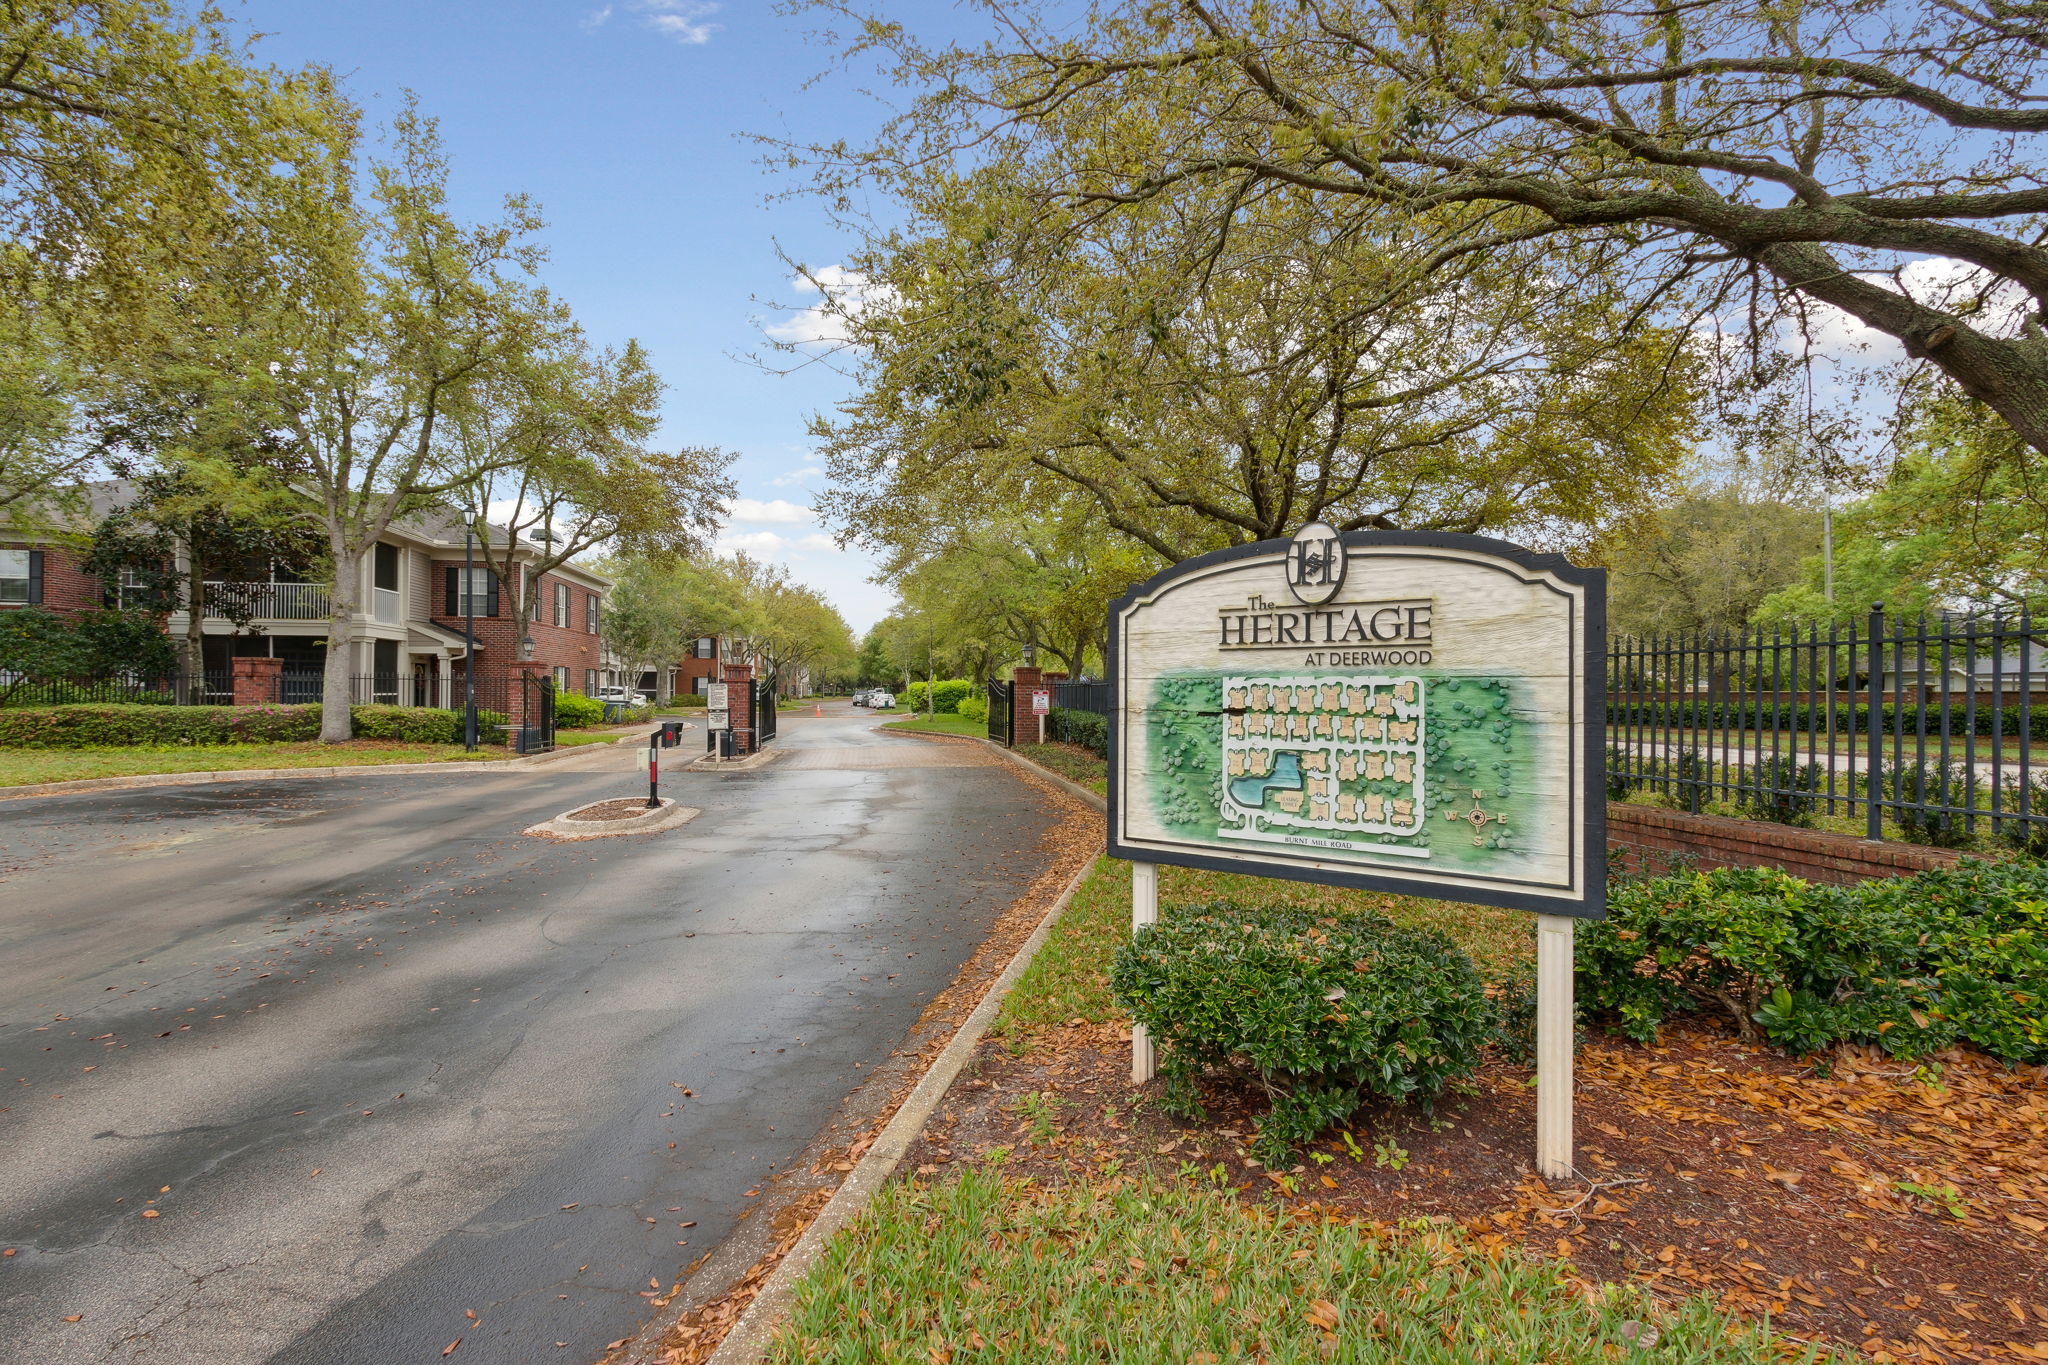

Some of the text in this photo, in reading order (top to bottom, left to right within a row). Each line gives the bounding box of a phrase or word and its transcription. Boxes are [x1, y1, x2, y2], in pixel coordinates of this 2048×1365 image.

[1248, 595, 1275, 611] The
[1219, 605, 1432, 645] HERITAGE
[1305, 651, 1432, 666] AT DEERWOOD
[1471, 789, 1482, 799] N
[1443, 810, 1459, 821] W
[1497, 813, 1508, 824] E
[1284, 836, 1352, 849] BURNT MILL ROAD
[1472, 836, 1483, 846] S
